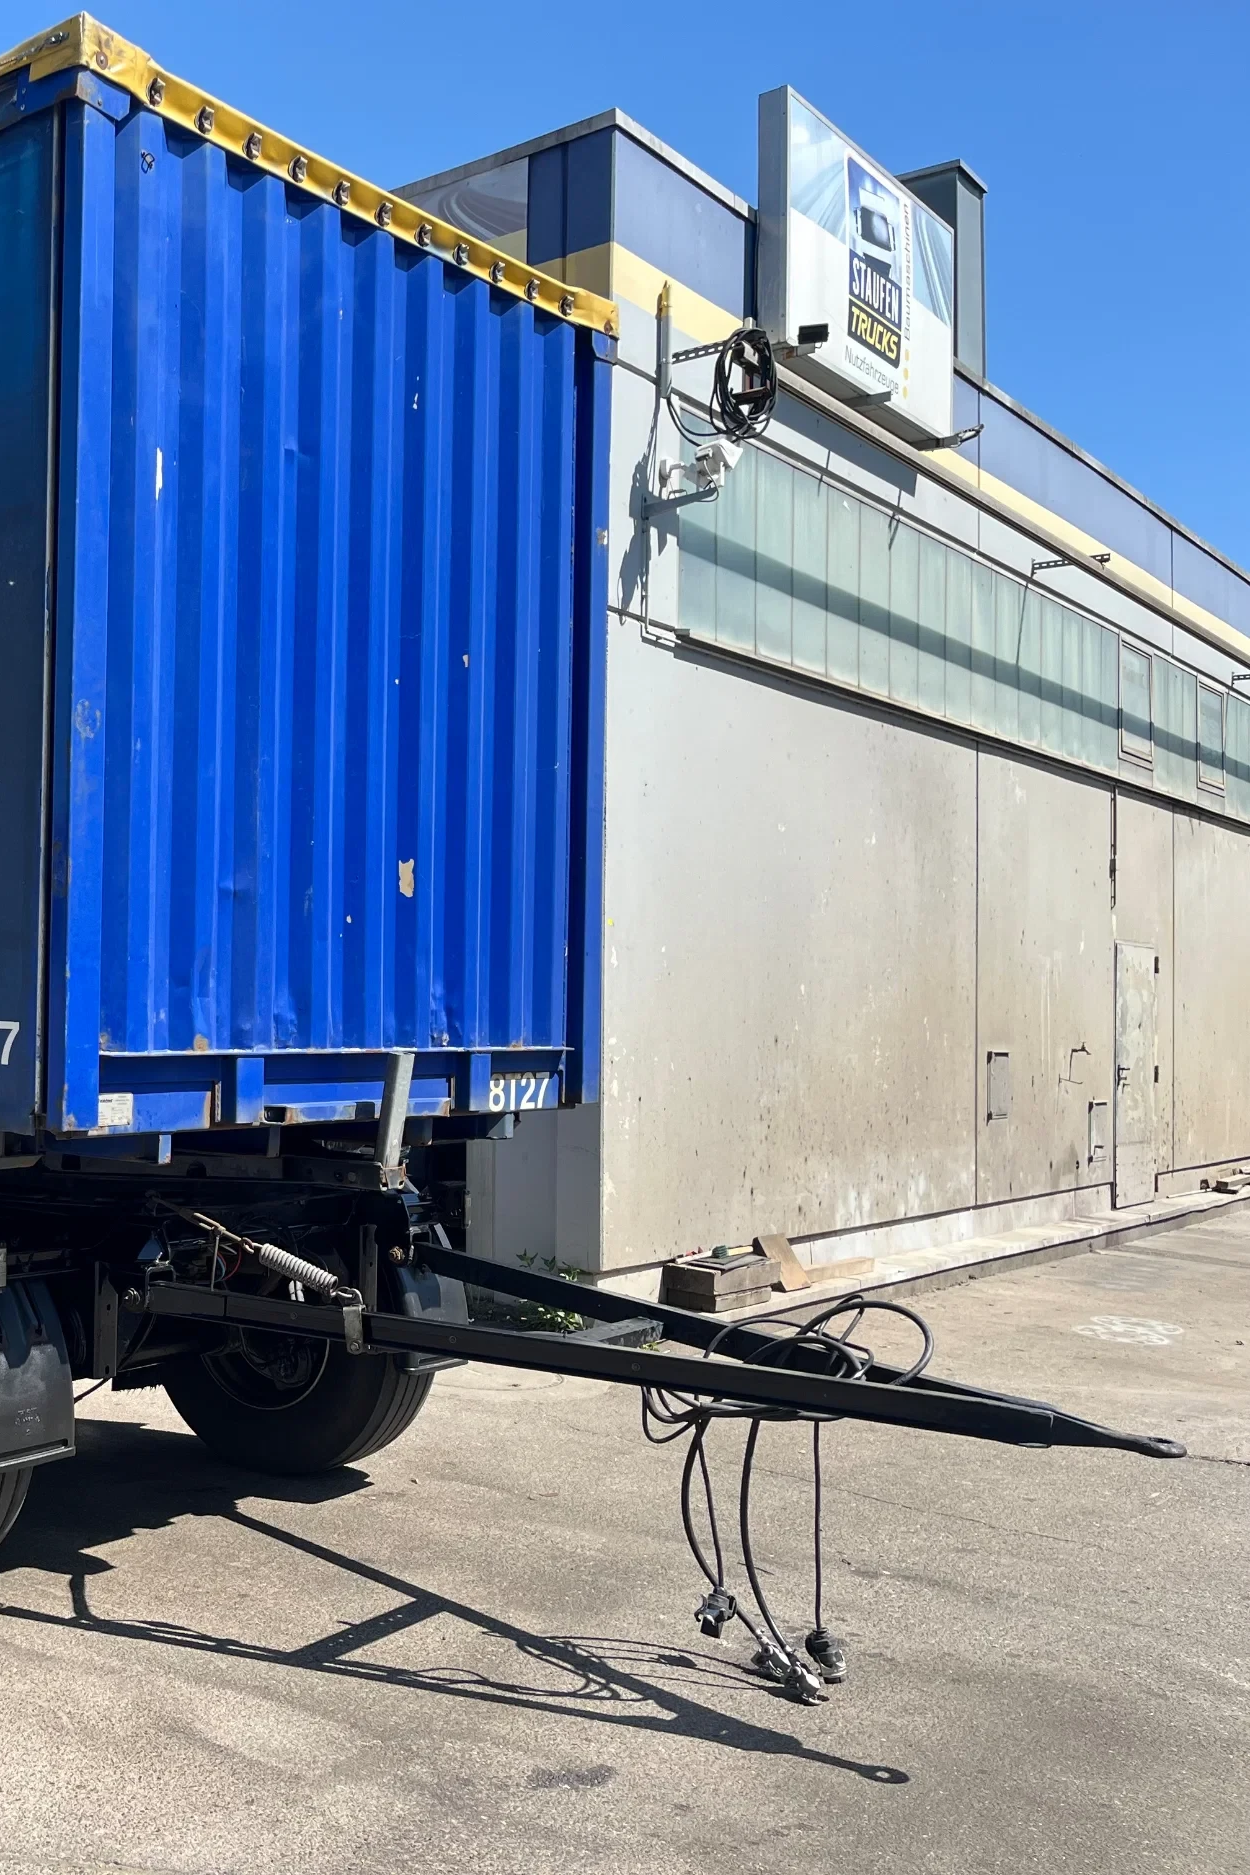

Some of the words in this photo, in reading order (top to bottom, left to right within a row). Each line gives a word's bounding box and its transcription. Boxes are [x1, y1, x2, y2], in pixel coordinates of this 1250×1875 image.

[852, 257, 899, 324] STAUFEN
[903, 203, 911, 341] Baumaschinen
[851, 305, 899, 360] TRUCKS
[844, 345, 900, 396] Nutzfahrzeuge
[489, 1071, 550, 1112] 8T27
